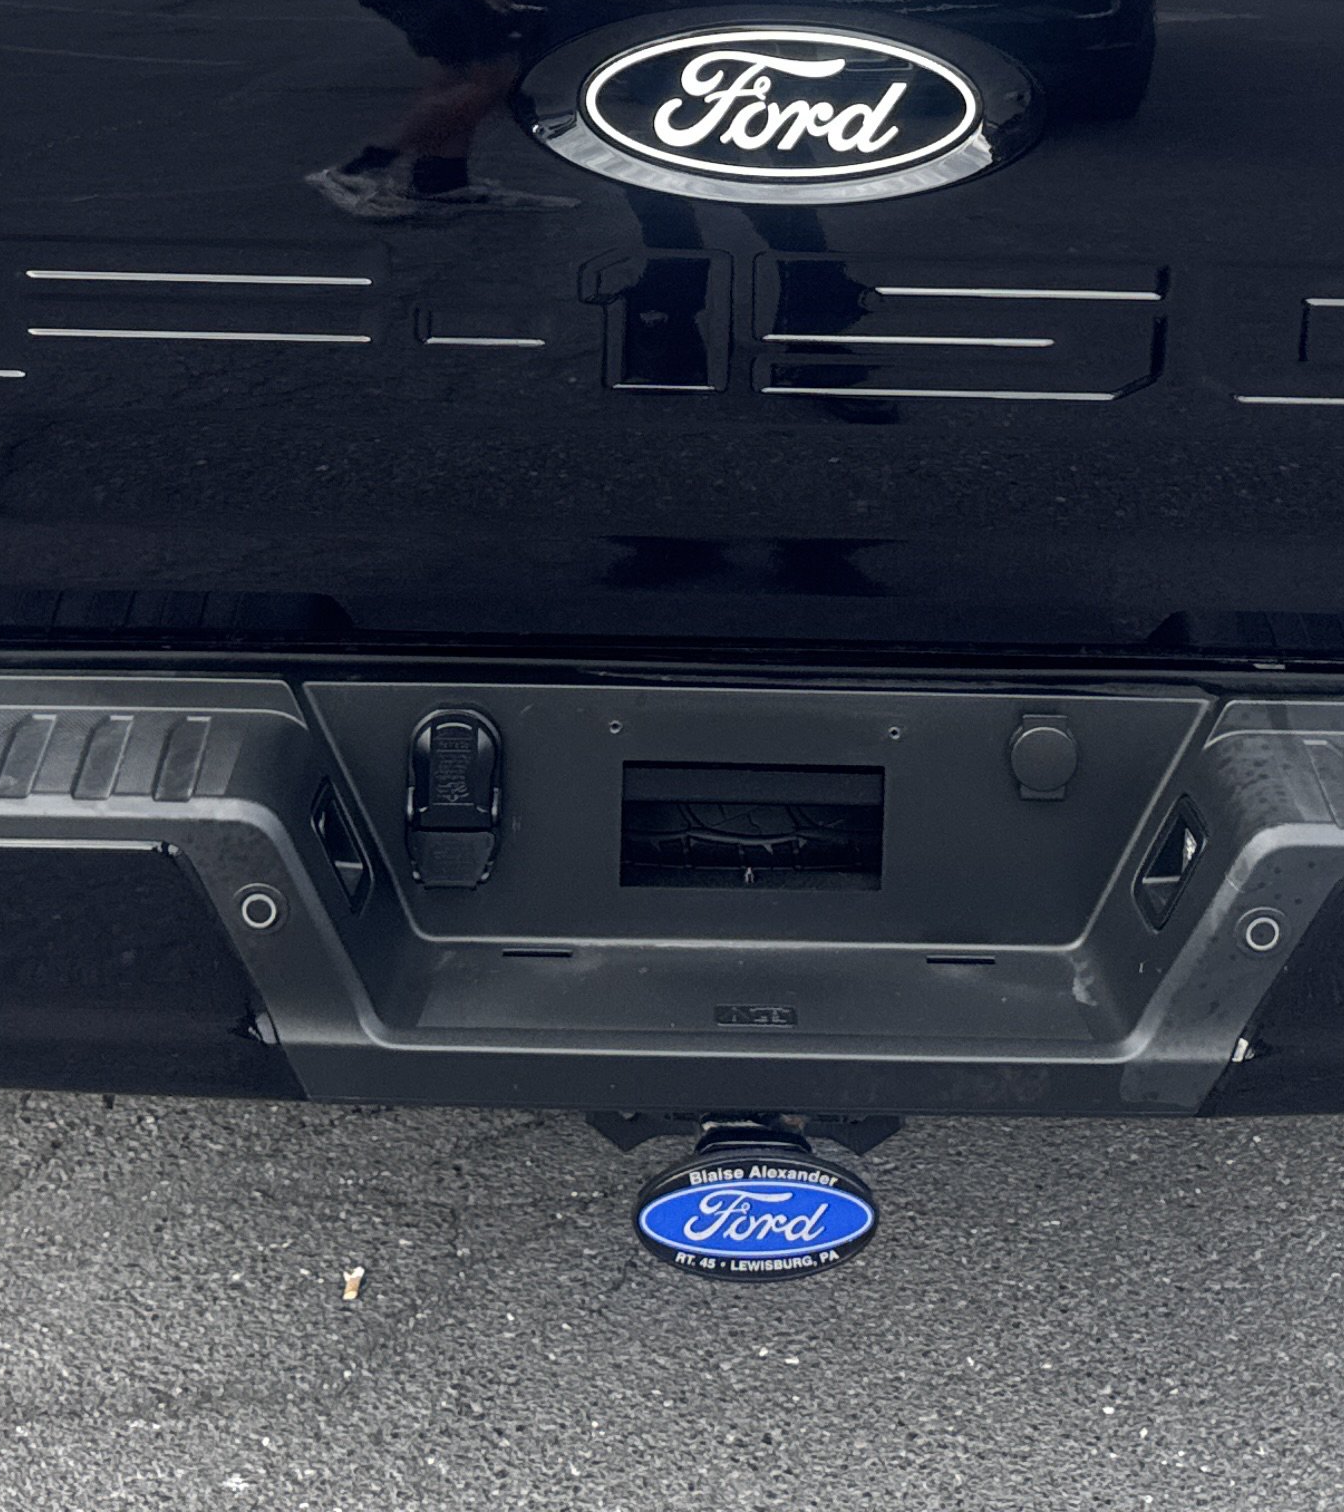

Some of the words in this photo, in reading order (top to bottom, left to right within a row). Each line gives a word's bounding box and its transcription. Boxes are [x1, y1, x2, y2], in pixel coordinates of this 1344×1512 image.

[652, 50, 908, 153] Ford
[689, 1167, 744, 1186] Blaise
[749, 1165, 839, 1188] Alexander
[683, 1189, 829, 1242] Ford
[675, 1252, 696, 1267] RT.
[699, 1257, 716, 1270] 45
[730, 1256, 818, 1272] LEWISBURG,
[820, 1250, 840, 1263] PA
